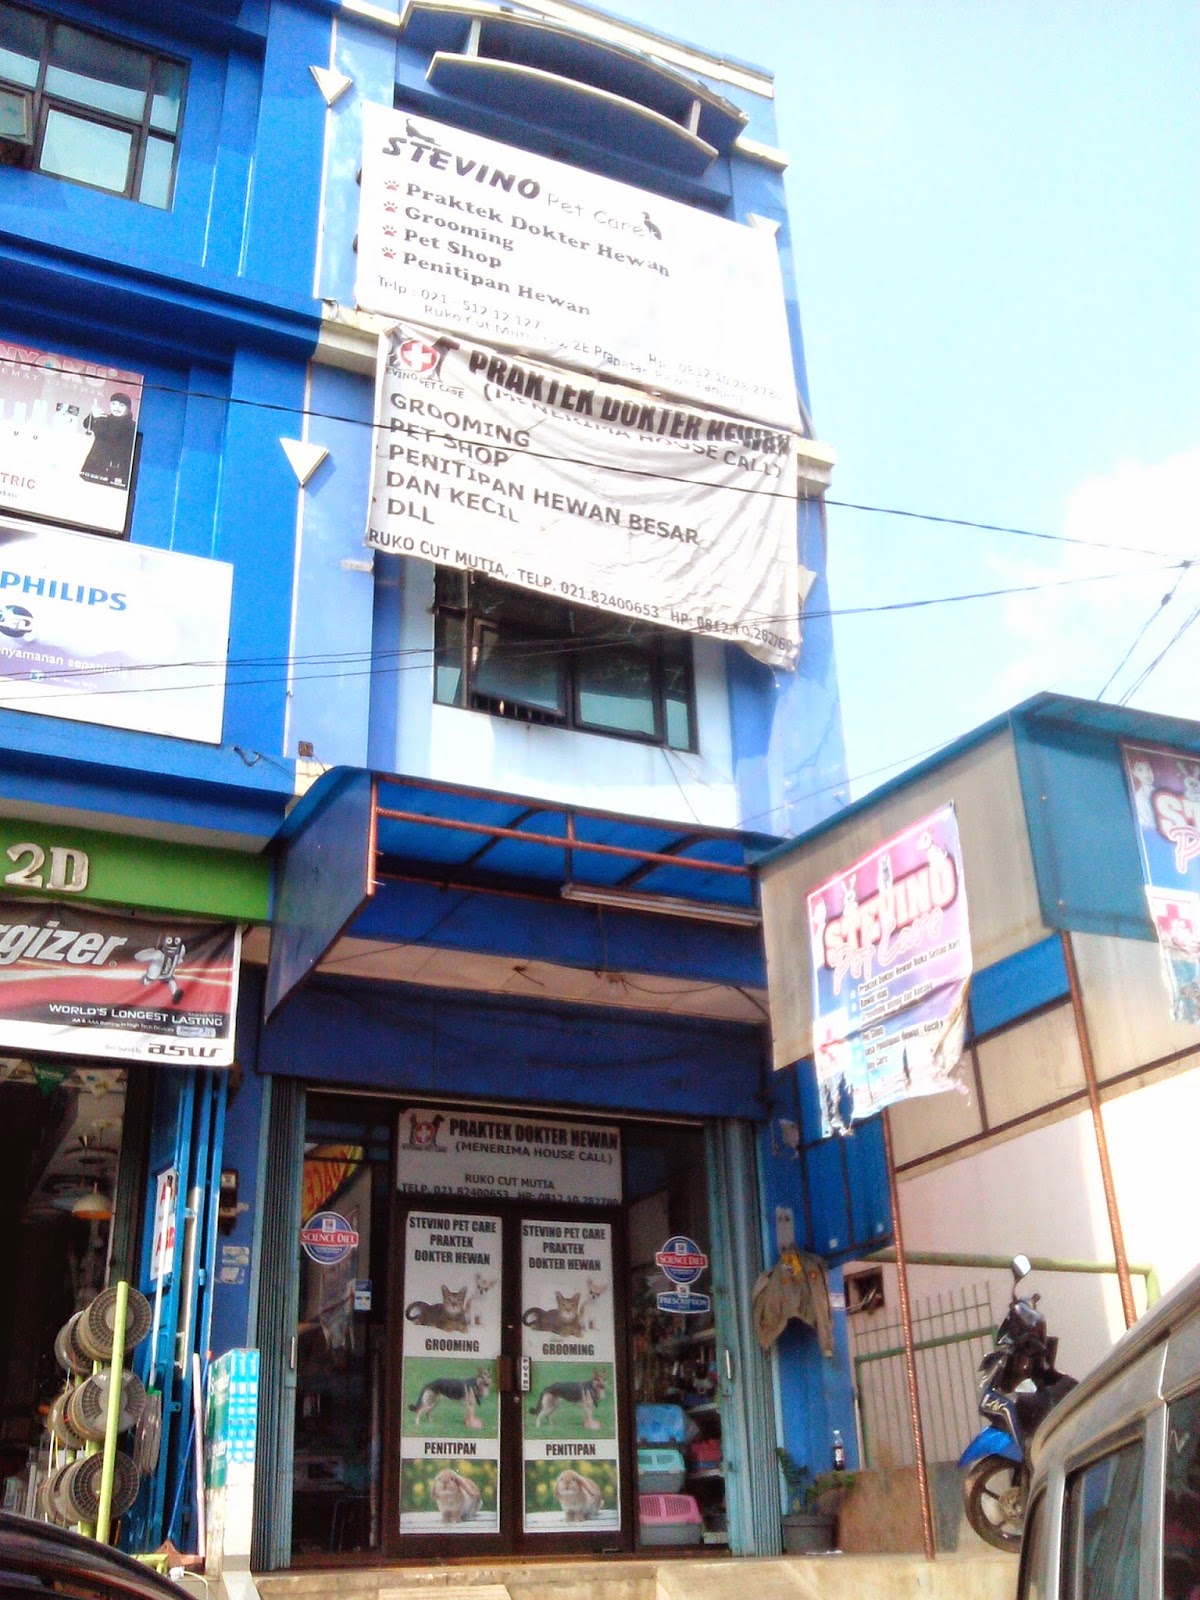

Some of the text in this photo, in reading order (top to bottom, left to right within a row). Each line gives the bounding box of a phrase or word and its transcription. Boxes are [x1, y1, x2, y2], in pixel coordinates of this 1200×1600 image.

[381, 137, 643, 238] STEVINO Pet Care
[404, 206, 515, 252] Grooming
[406, 183, 671, 278] Praktek Dokter Hewan
[404, 228, 502, 268] Pet Shop
[403, 251, 591, 316] Penitipan Hewan
[469, 350, 790, 457] PRAKTEK DOKTER HEWAN
[390, 393, 530, 448] GROOMING
[390, 417, 509, 467] PET SHOP
[386, 471, 520, 524] DAN KECIL
[389, 444, 700, 546] PENITIPAN HEWAN BESAR
[388, 499, 435, 525] DLL
[368, 528, 415, 551] RUKO
[420, 540, 450, 561] CUT
[0, 570, 128, 611] PHILIPS
[0, 646, 64, 666] nyamanan
[5, 842, 89, 891] 2D
[49, 1003, 223, 1027] WORLD'S LONGEST LASTING
[449, 1118, 619, 1150] PRAKTEK DOKTER HEWAN
[455, 1141, 531, 1157] (MENERIMA
[534, 1146, 575, 1160] HOUSE
[578, 1151, 613, 1165] CALL)
[464, 1173, 494, 1185] RUKO
[498, 1175, 517, 1187] CUT
[302, 1231, 336, 1243] SCIENCE
[409, 1216, 497, 1234] STEVINO PET CARE
[523, 1225, 606, 1240] STEVINO PET CARE
[430, 1234, 474, 1249] PRAKTEK
[543, 1242, 585, 1255] PRAKTEK
[414, 1250, 491, 1266] DOKTER HEWAN
[529, 1256, 602, 1272] DOKTER HEWAN
[425, 1338, 480, 1353] GROOMING
[542, 1343, 595, 1356] GROOMING
[424, 1441, 477, 1456] PENITIPAN
[545, 1443, 596, 1456] PENITIPAN
